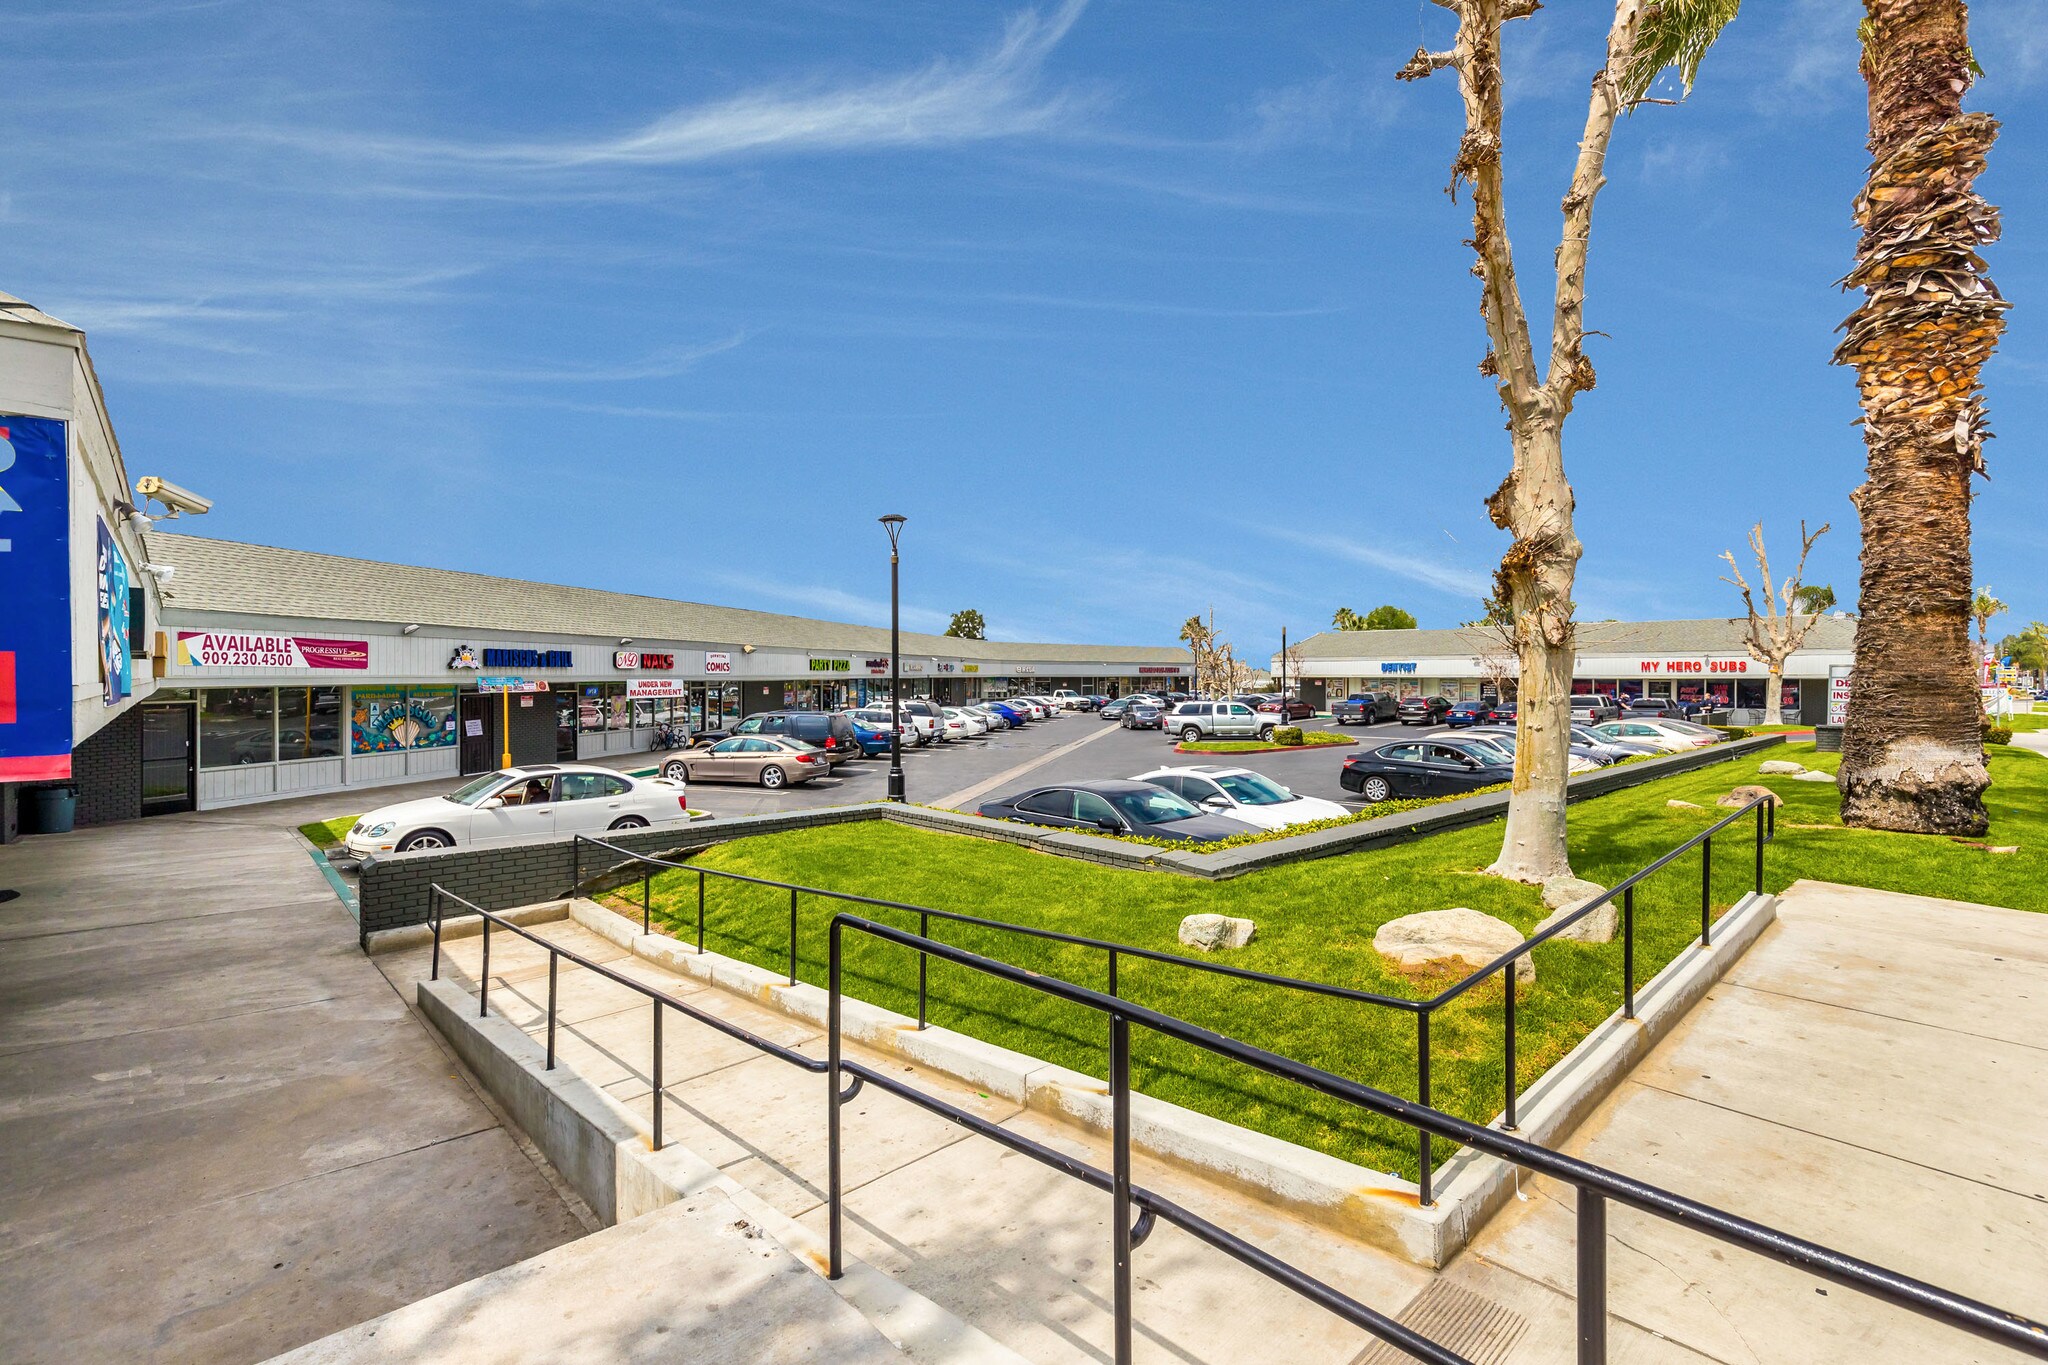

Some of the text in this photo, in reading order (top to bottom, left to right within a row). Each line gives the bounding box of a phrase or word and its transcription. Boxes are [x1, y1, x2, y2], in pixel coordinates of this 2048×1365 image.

[202, 634, 292, 653] AVAILABLE
[301, 646, 349, 655] PROGRESSIVE
[202, 651, 293, 666] 909.230.4500
[484, 649, 538, 668] MARISCOS
[547, 650, 573, 668] GRILL
[641, 654, 674, 669] NAILS
[706, 662, 730, 672] COMICS
[810, 659, 851, 671] PARTY PIZZA
[1381, 663, 1417, 674] DENTIST
[1641, 661, 1747, 673] MY HERO SUBS
[629, 688, 683, 697] MANAGEMENT
